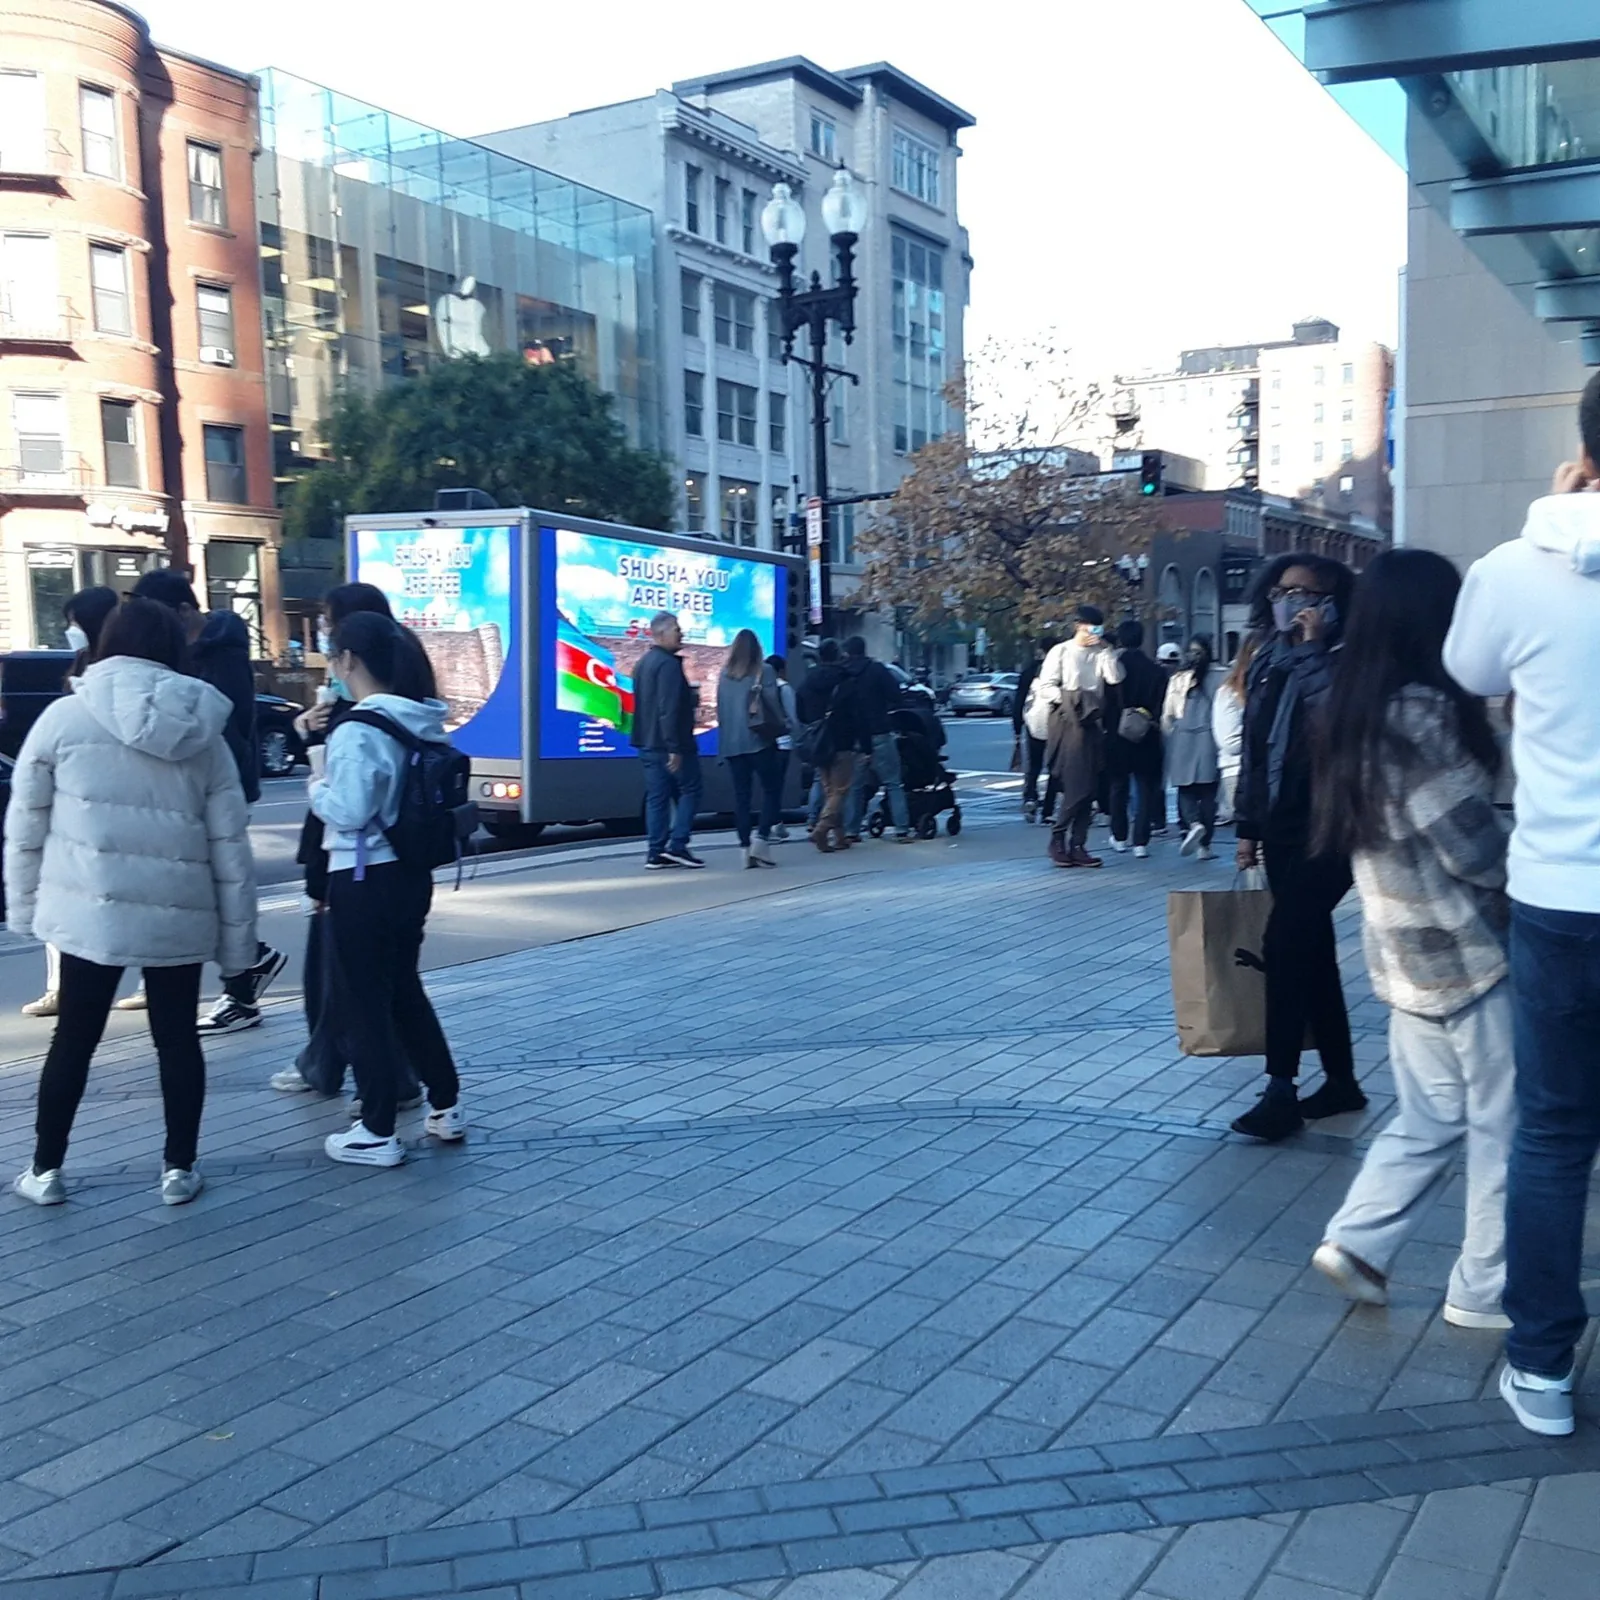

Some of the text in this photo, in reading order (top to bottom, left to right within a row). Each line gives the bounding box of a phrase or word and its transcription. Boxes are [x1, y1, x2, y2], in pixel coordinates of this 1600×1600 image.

[619, 557, 729, 590] SHUSHA YOU
[631, 586, 714, 613] ARE FREE
